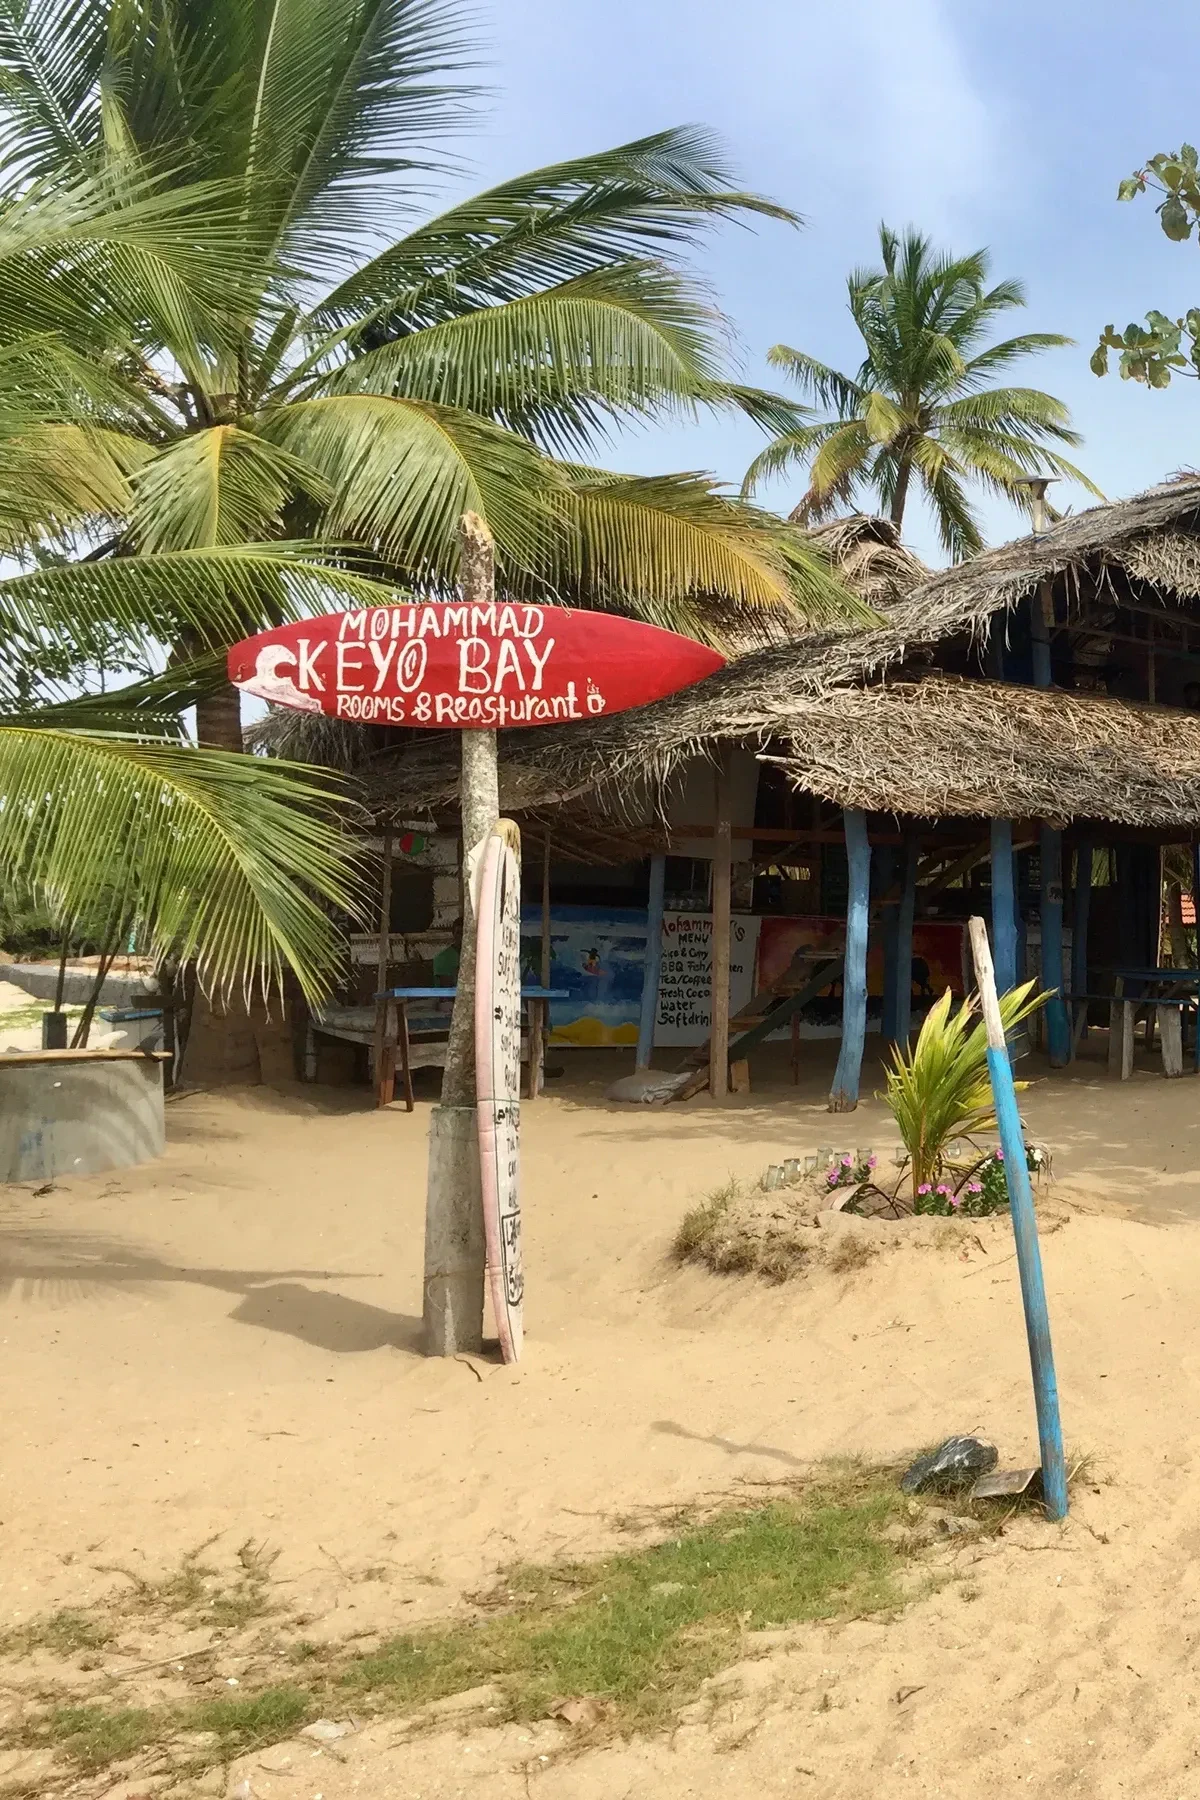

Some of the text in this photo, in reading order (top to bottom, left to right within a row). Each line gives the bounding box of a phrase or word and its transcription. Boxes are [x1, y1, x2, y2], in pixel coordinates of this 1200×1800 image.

[338, 606, 544, 640] MOHAMMAD
[297, 637, 555, 694] KEYO BAY
[336, 694, 405, 722] ROOMS
[678, 933, 709, 945] MENU
[659, 975, 712, 986] Tea/Coffee
[659, 987, 684, 999] Fresh
